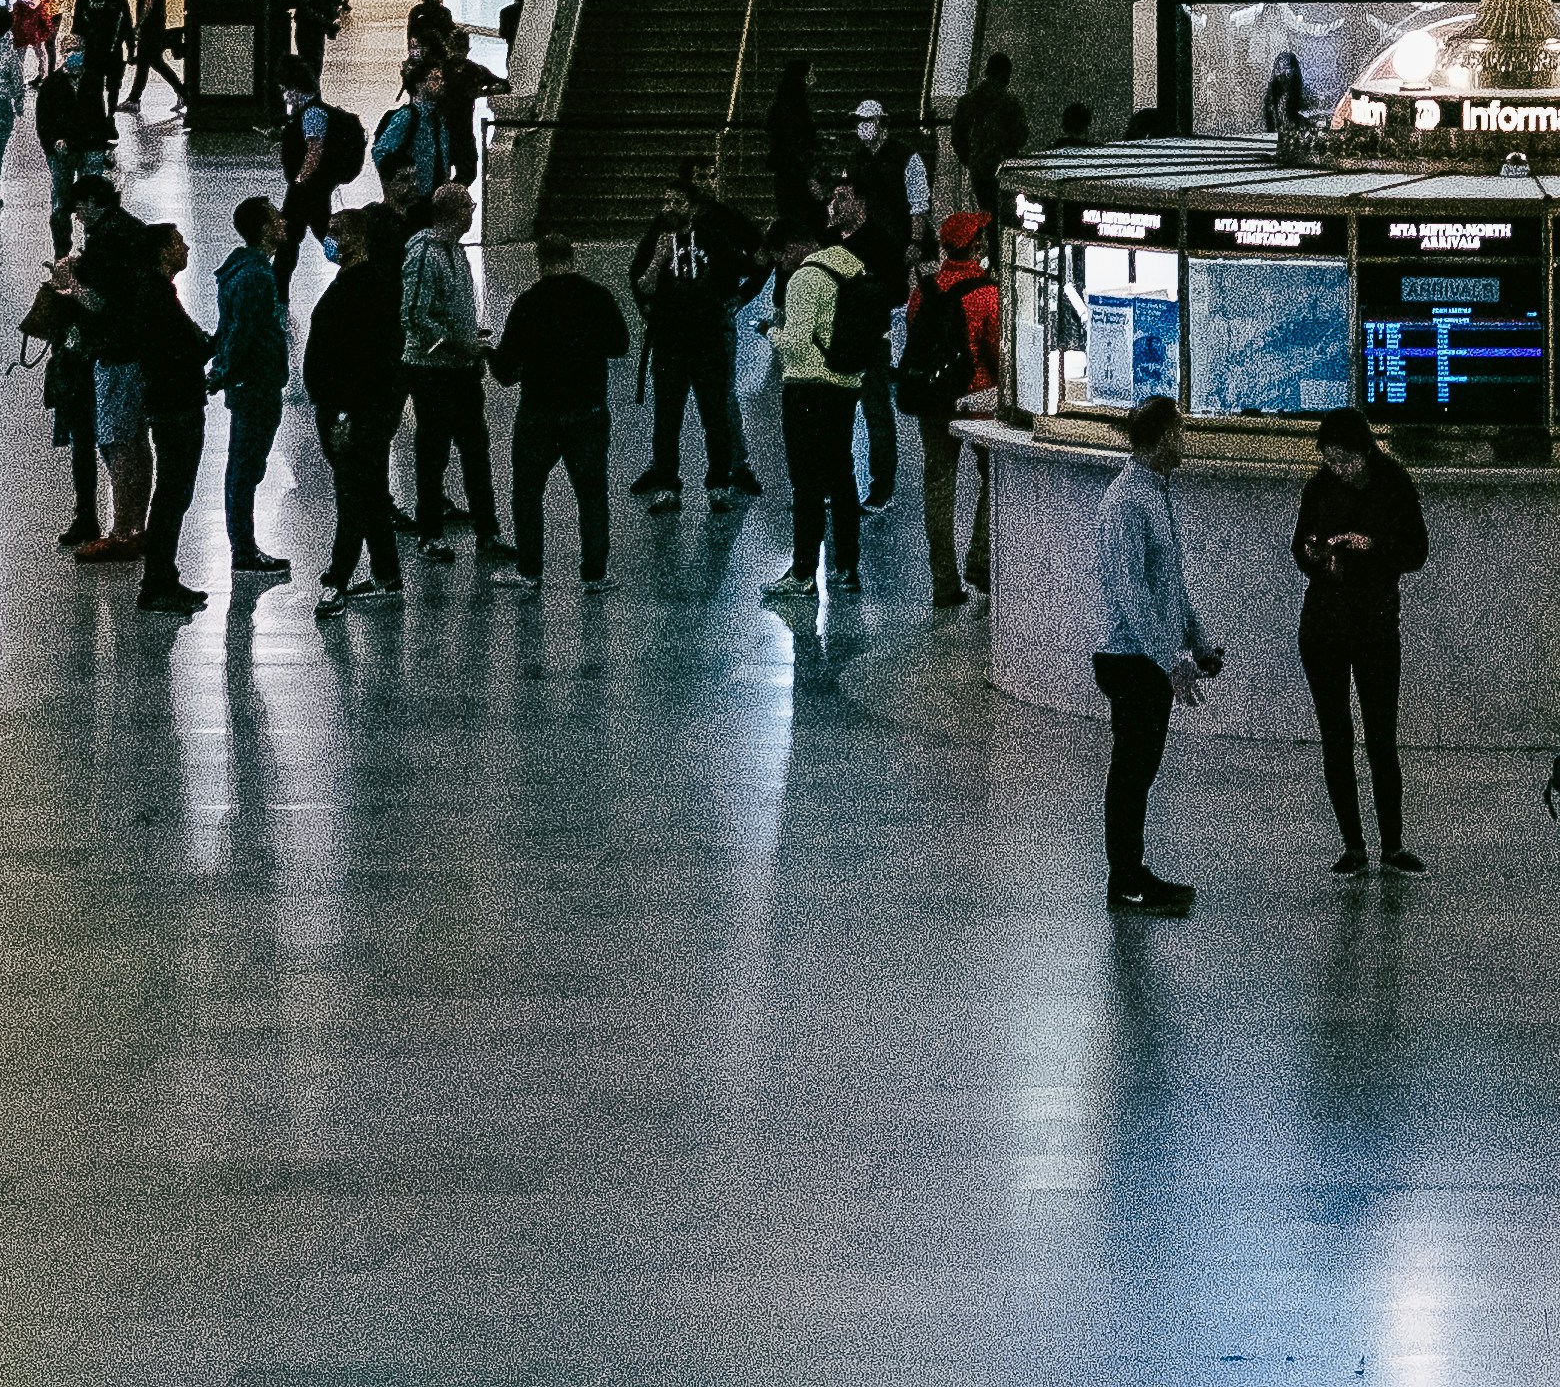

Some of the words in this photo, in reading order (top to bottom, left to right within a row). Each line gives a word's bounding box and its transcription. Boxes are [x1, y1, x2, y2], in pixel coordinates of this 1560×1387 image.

[1215, 219, 1237, 232] MTA
[1241, 219, 1322, 235] METRO-NORTH
[1389, 224, 1416, 237] MTA
[1419, 224, 1512, 238] METRO-NORTH
[1236, 233, 1300, 246] TIMETABLES
[1421, 237, 1480, 249] ARRIVALS
